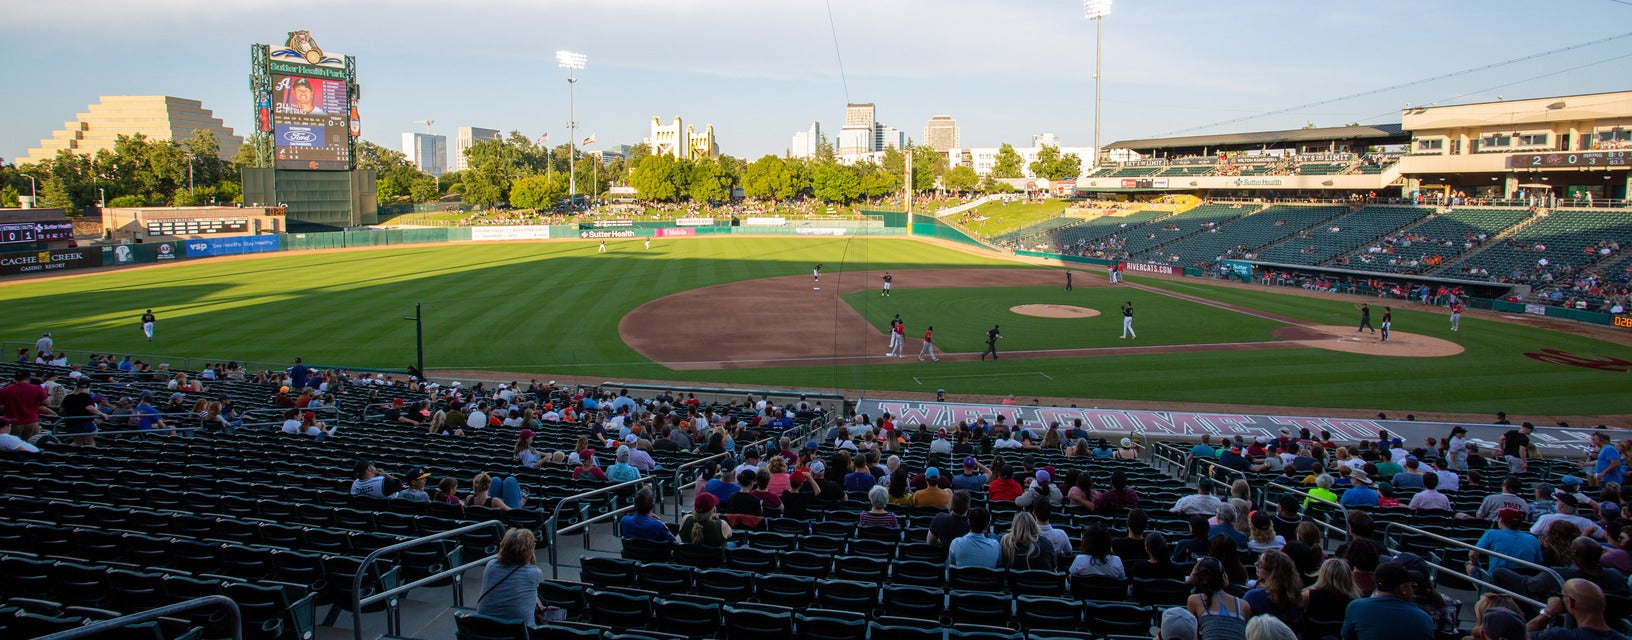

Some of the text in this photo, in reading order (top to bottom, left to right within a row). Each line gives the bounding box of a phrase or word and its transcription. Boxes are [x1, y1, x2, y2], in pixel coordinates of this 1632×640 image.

[270, 62, 346, 78] Sutter Health Park
[290, 132, 311, 141] Ford
[1293, 154, 1315, 162] SKY'S
[1532, 154, 1578, 165] 2 0
[1589, 157, 1596, 165] 3
[9, 231, 31, 241] 0 1
[588, 229, 635, 238] Sutter Health
[189, 242, 208, 251] vsp
[1, 252, 83, 266] CACHE CREEK
[1126, 262, 1173, 274] RIVERCATS.COM
[878, 402, 1275, 438] WELCOME
[1503, 501, 1521, 509] POSEY
